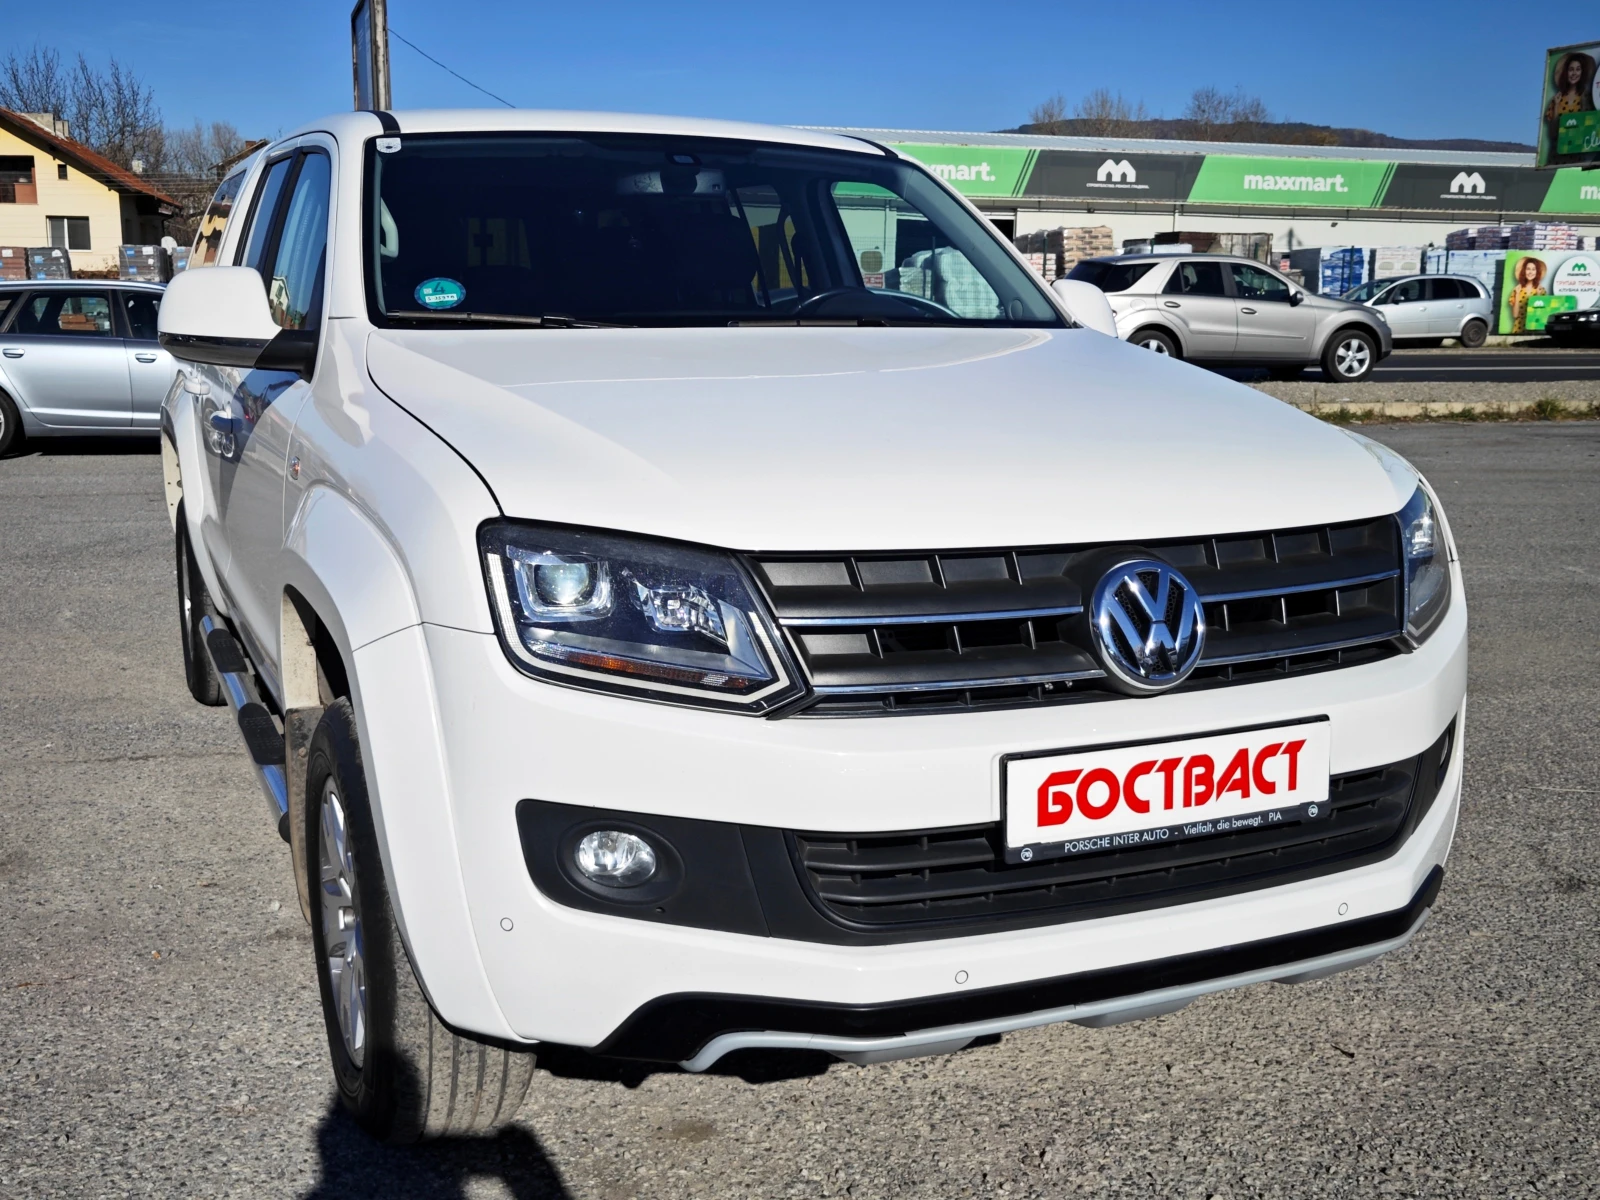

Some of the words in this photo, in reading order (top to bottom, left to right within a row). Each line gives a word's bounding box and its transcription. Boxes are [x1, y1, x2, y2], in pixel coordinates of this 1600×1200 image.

[1243, 174, 1349, 192] maxxmart.
[1064, 837, 1110, 853] PORSCHE
[1113, 832, 1140, 847] INTER
[1142, 828, 1169, 841] AUTO
[1183, 822, 1215, 835] Vielfalt,
[1217, 819, 1230, 830] die
[1232, 815, 1263, 827] bewegt.
[1268, 811, 1282, 822] PIA
